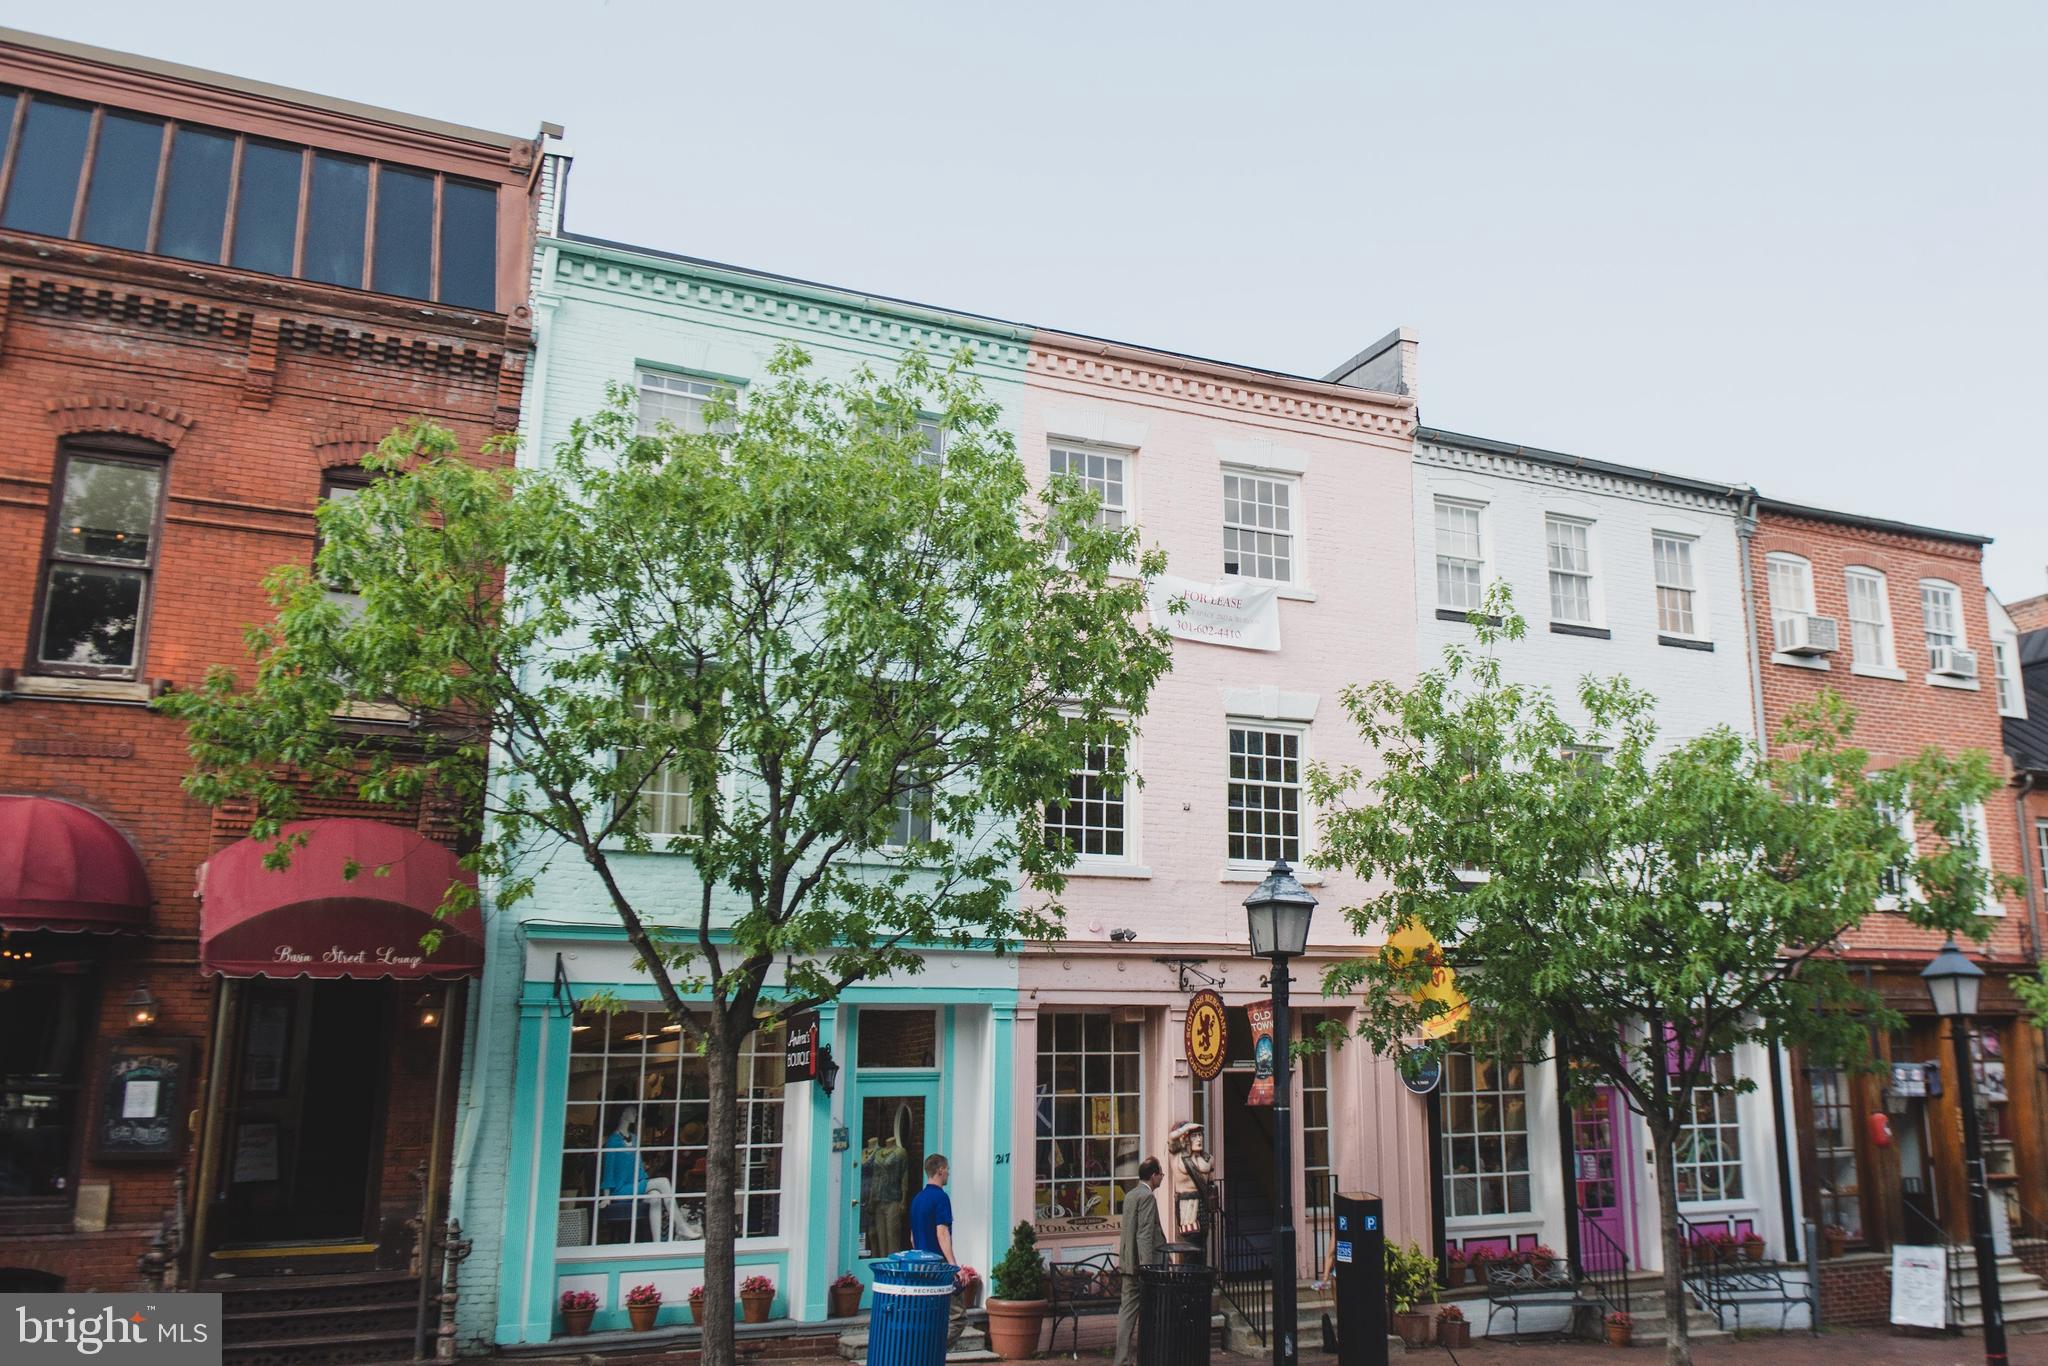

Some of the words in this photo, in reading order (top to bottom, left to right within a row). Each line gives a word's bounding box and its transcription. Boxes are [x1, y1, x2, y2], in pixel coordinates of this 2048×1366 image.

[1183, 590, 1207, 603] FOR
[1211, 596, 1243, 609] LEASE
[273, 944, 312, 963] Basin
[322, 945, 367, 964] Street
[376, 946, 423, 969] Lounge
[1186, 994, 1204, 1039] SCOTTISH
[1205, 993, 1227, 1037] MERCHANT
[1253, 1010, 1271, 1022] OLD
[1251, 1020, 1274, 1031] TOWN
[1187, 1046, 1225, 1079] TOBACCONIST
[996, 1152, 1010, 1164] 217
[1036, 1222, 1121, 1233] TOBACCONI
[1367, 1217, 1375, 1229] P
[913, 1286, 945, 1294] RECYCLING
